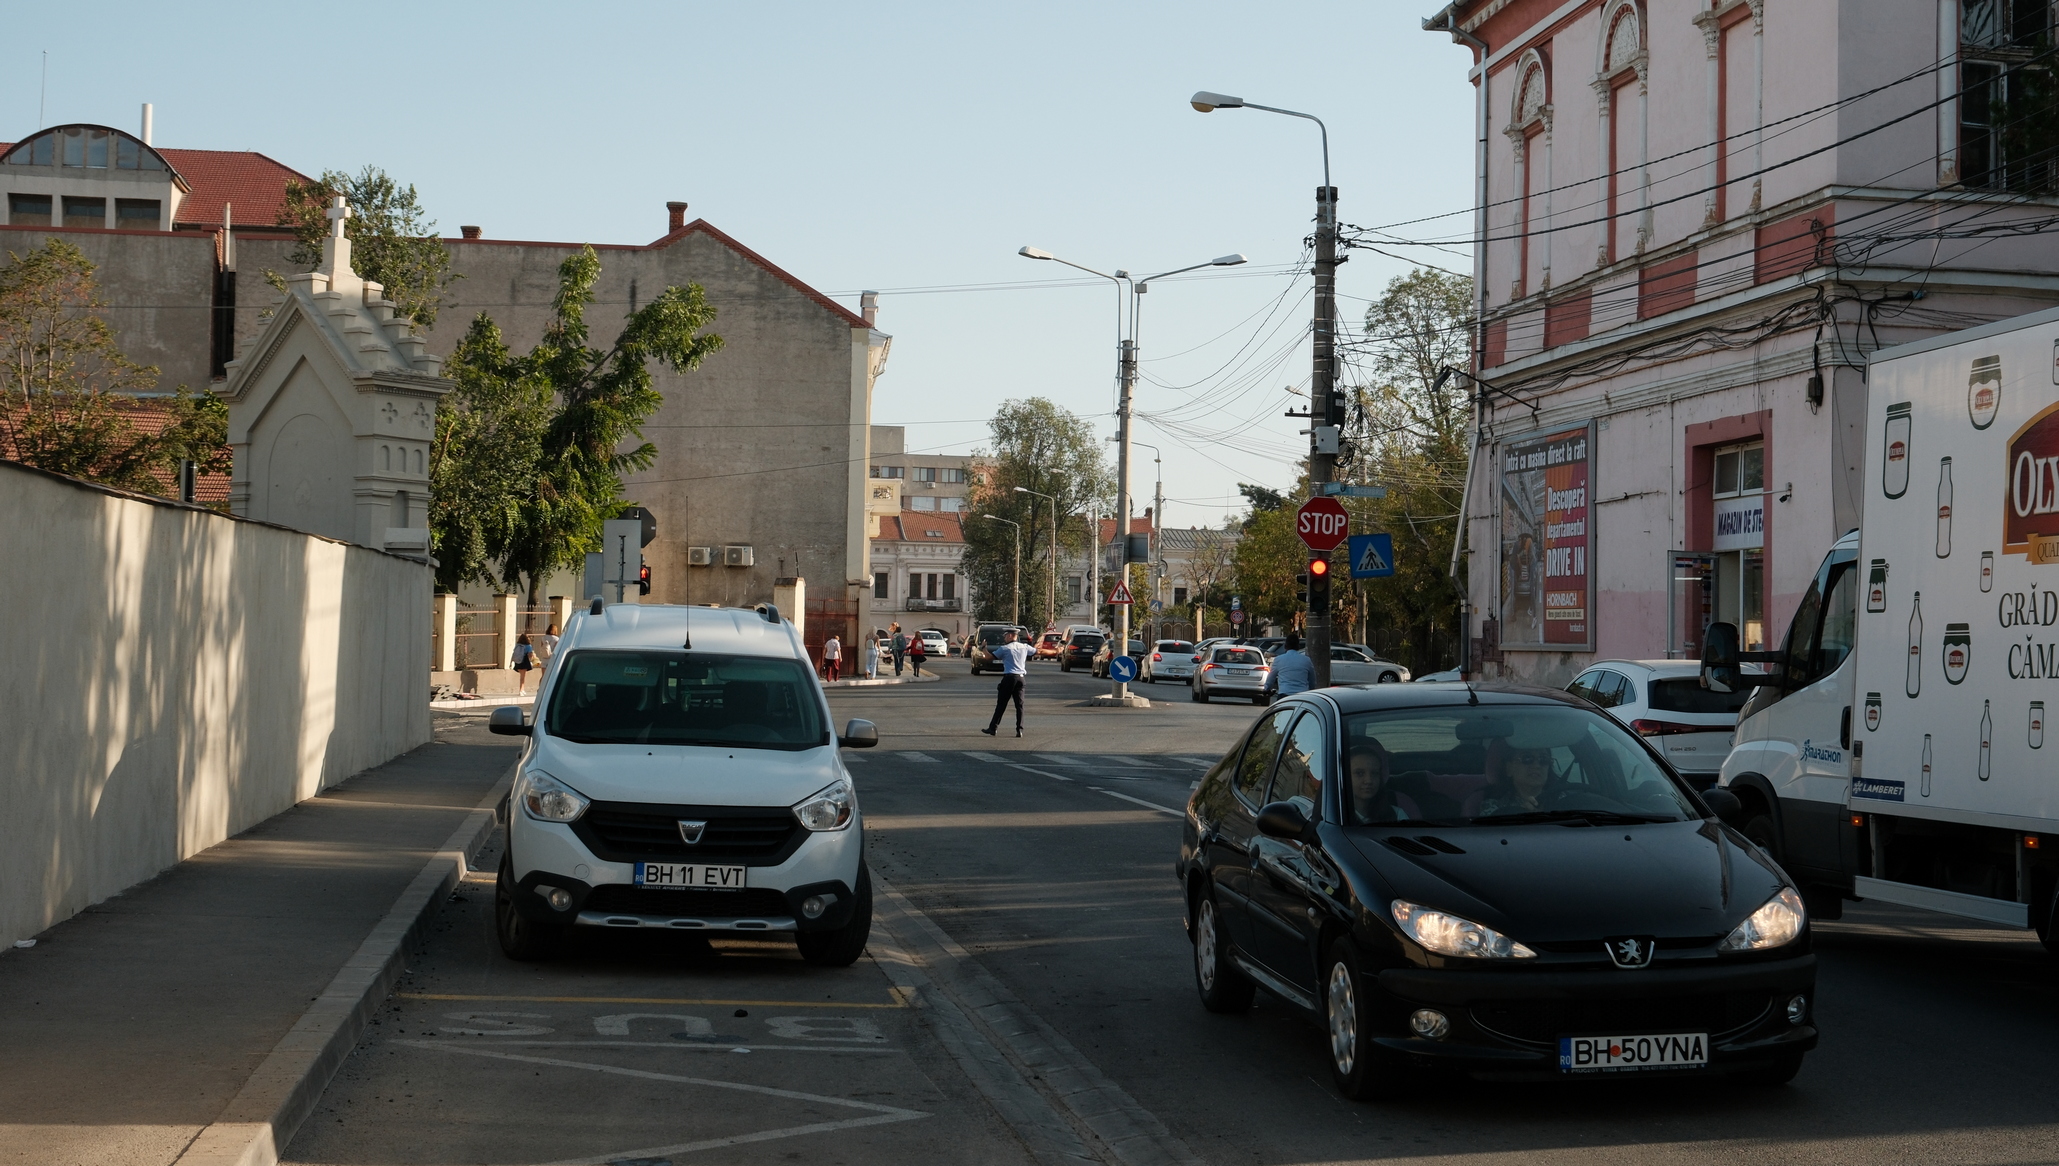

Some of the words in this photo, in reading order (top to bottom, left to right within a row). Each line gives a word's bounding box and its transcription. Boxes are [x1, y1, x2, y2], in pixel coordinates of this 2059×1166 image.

[1505, 451, 1519, 471] Intră
[1520, 455, 1526, 470] cu
[1547, 444, 1565, 465] direct
[1566, 442, 1572, 462] la
[1573, 439, 1586, 460] raft
[1547, 480, 1585, 515] Descoperă
[1299, 512, 1346, 535] STOP
[1547, 517, 1585, 543] departamentul
[1717, 511, 1743, 536] MAGAZIN
[1743, 509, 1752, 534] DE
[1546, 547, 1571, 577] DRIVE
[1574, 546, 1585, 576] IN
[1546, 592, 1577, 607] HORNBACH
[1862, 785, 1904, 796] LAMBERET
[645, 865, 673, 883] BH
[680, 866, 693, 884] 11
[704, 867, 743, 886] EVT
[439, 1011, 890, 1043] BUS
[1560, 1055, 1571, 1066] RO
[1574, 1039, 1611, 1065] BH
